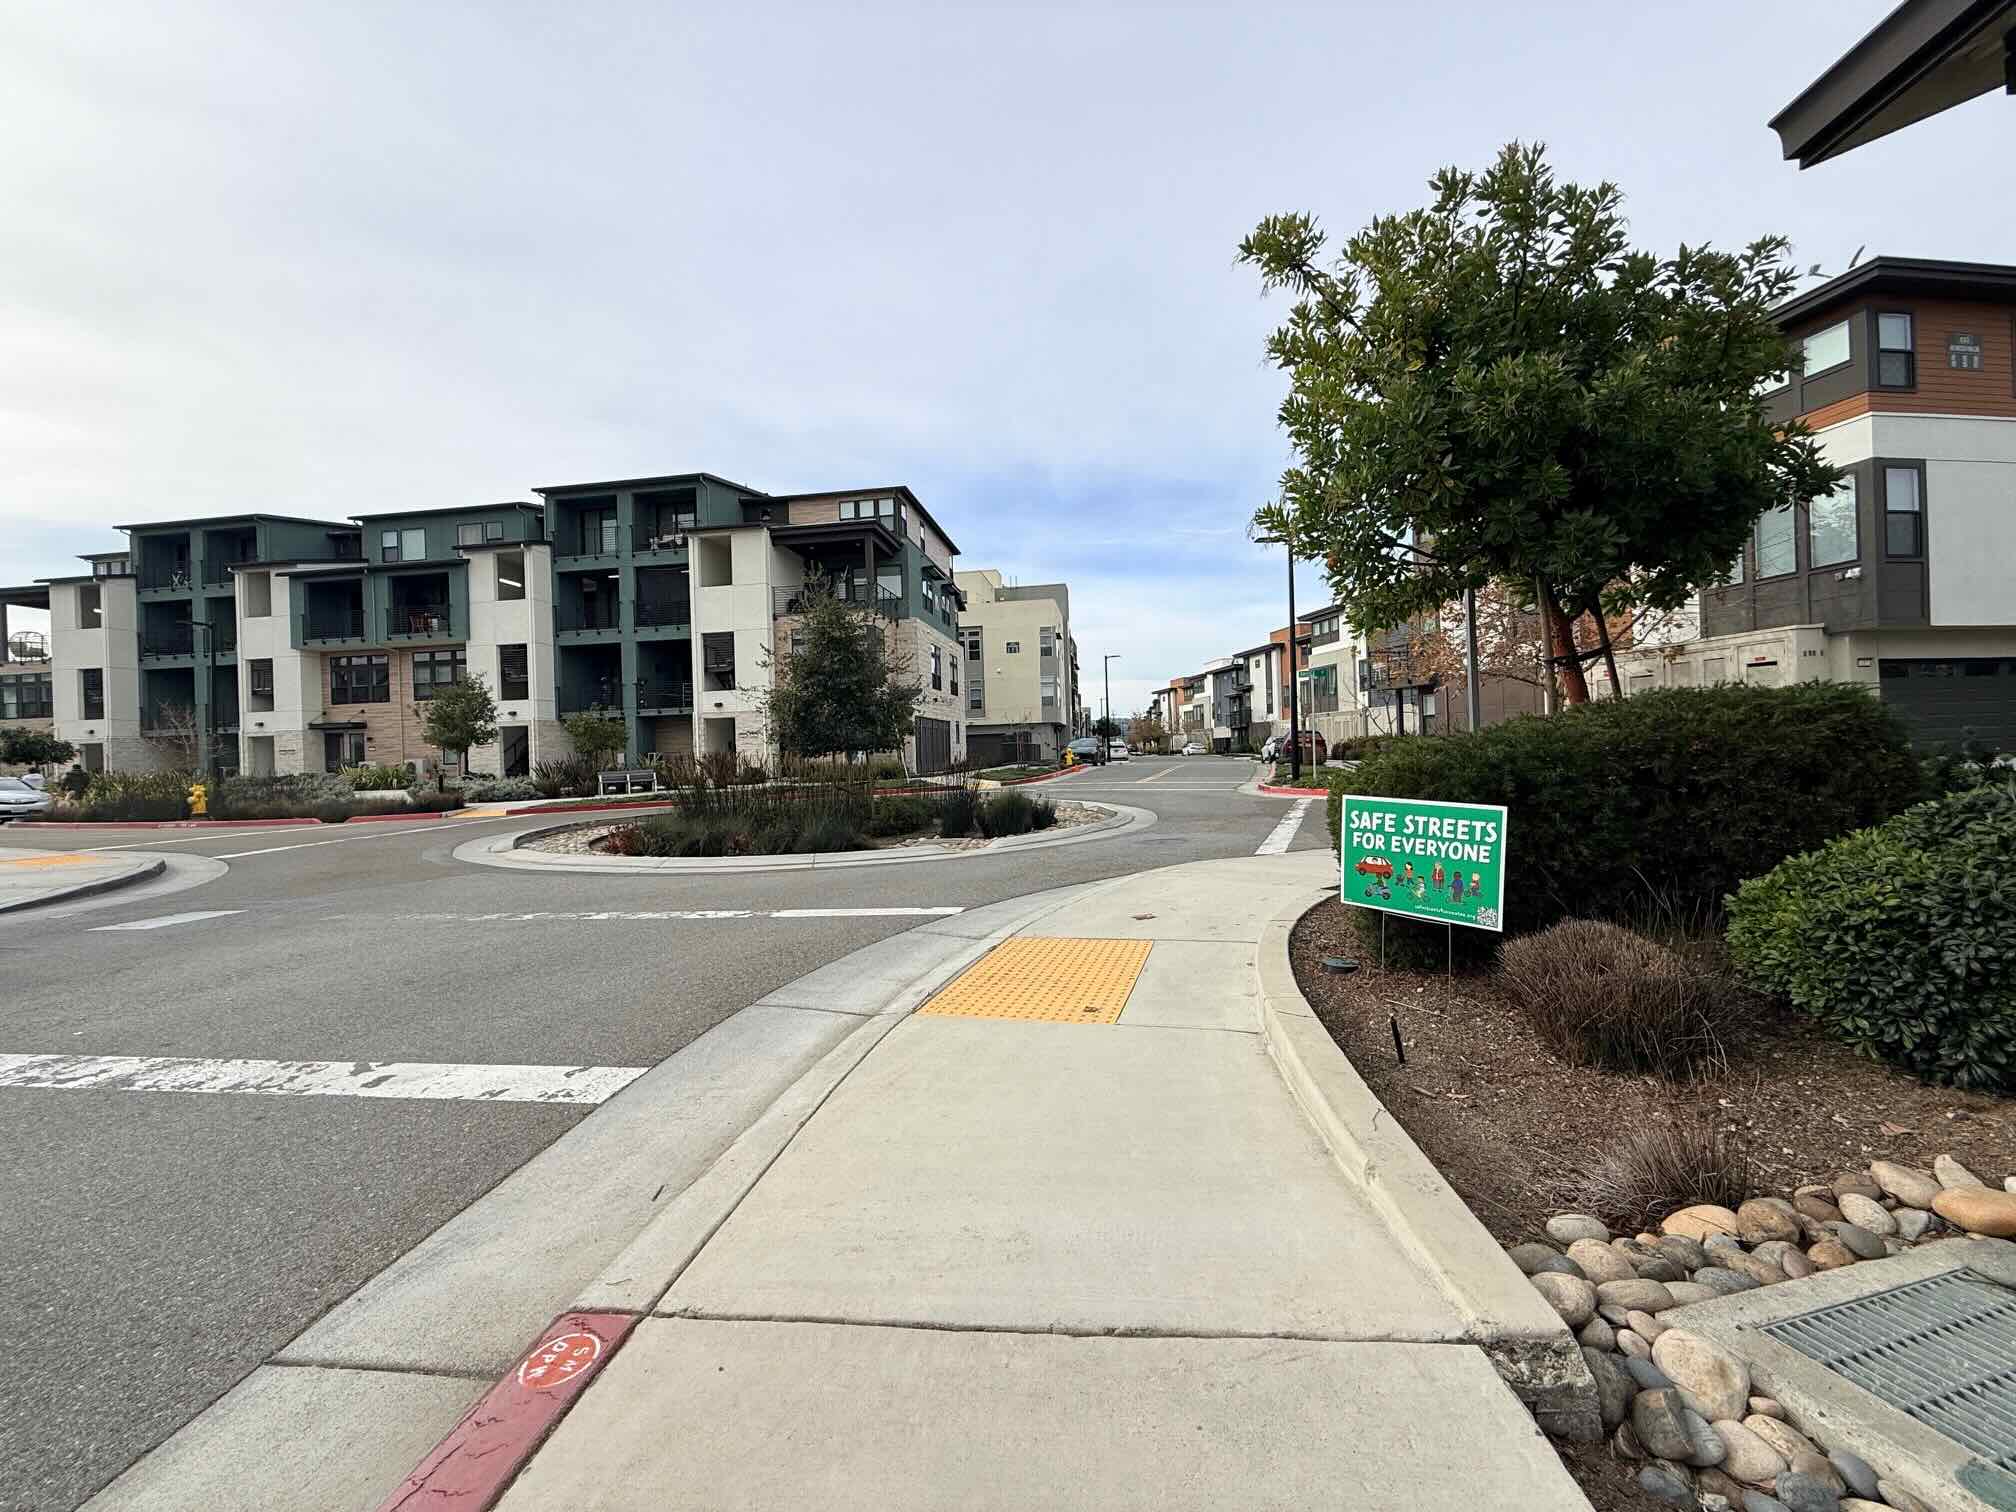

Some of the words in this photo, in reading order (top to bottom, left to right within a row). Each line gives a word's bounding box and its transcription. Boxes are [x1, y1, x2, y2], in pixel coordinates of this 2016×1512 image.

[1350, 810, 1397, 833] SAFE
[1402, 814, 1499, 843] STREETS
[1352, 832, 1386, 850] FOR
[1391, 836, 1492, 864] EVERYONE
